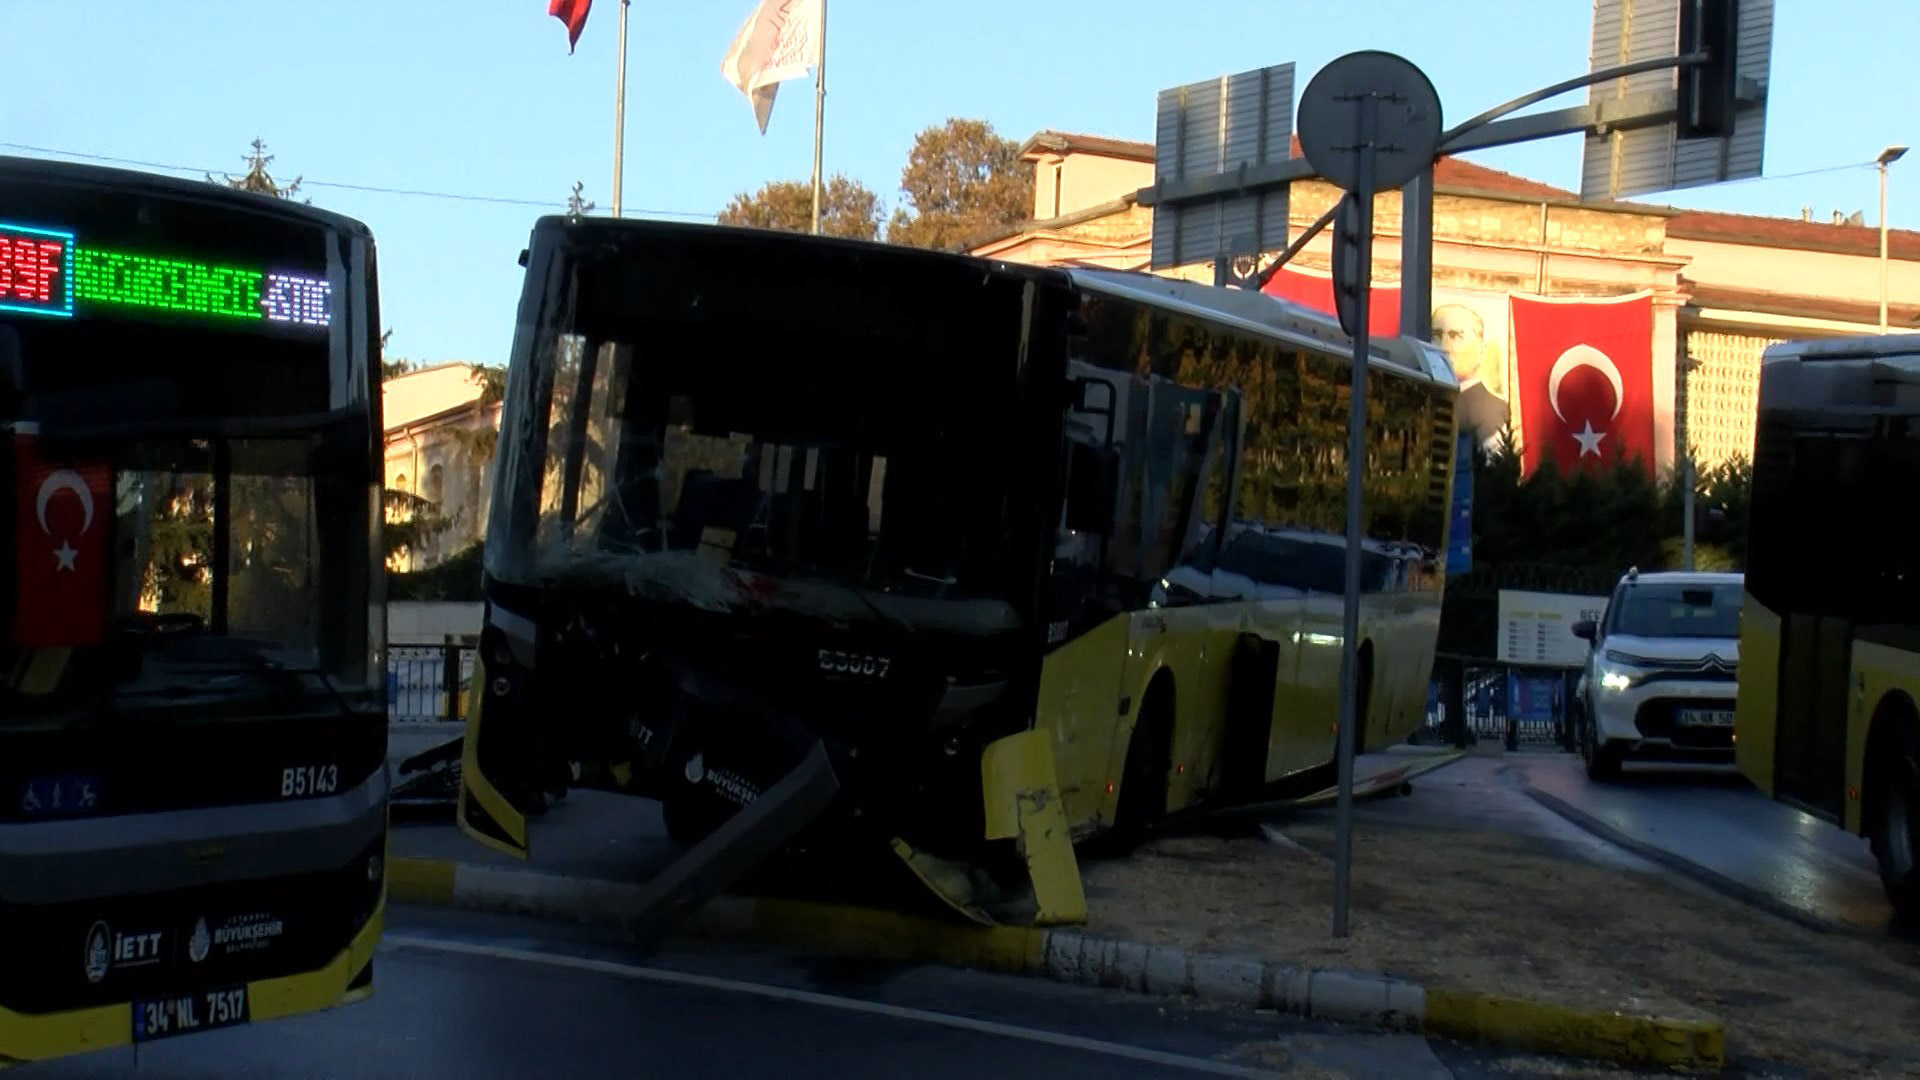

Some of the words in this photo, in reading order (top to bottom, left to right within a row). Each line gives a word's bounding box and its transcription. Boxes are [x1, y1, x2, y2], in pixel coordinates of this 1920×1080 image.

[281, 763, 338, 798] B5143
[115, 930, 162, 961] İETT
[147, 1000, 169, 1035] 34
[176, 997, 200, 1030] NL
[206, 988, 246, 1025] 7517
